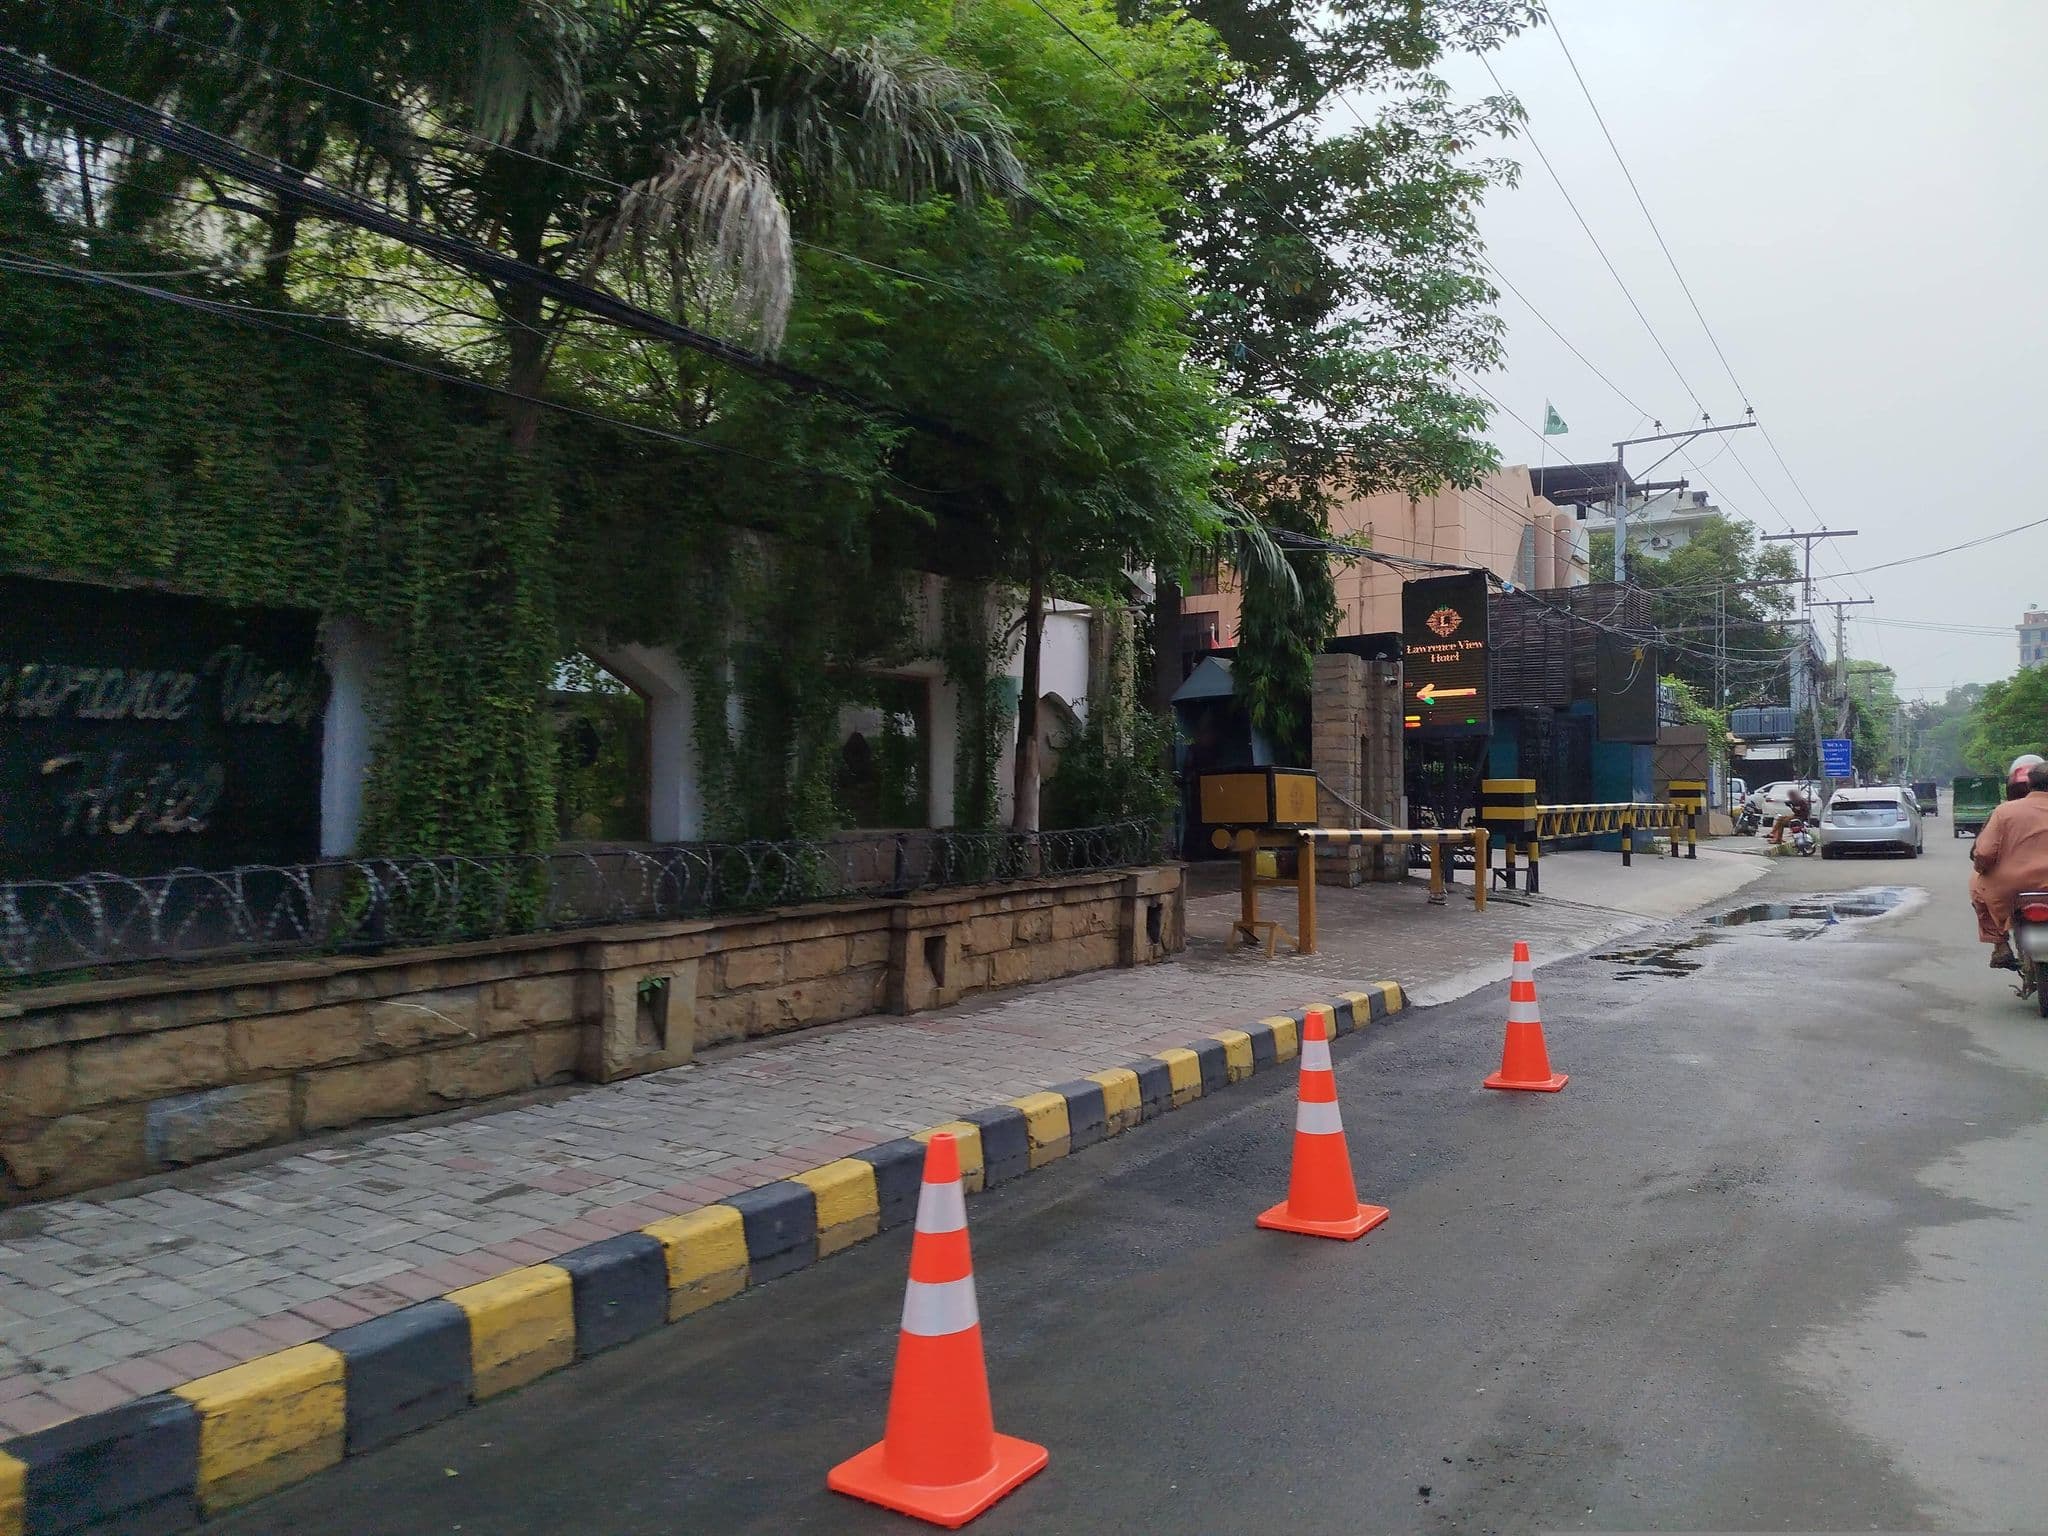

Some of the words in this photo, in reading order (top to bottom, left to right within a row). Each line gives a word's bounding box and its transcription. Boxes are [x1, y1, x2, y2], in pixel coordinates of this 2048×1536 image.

[1406, 643, 1457, 655] Lawrence
[1457, 639, 1484, 650] View
[1430, 651, 1460, 663] Hotel
